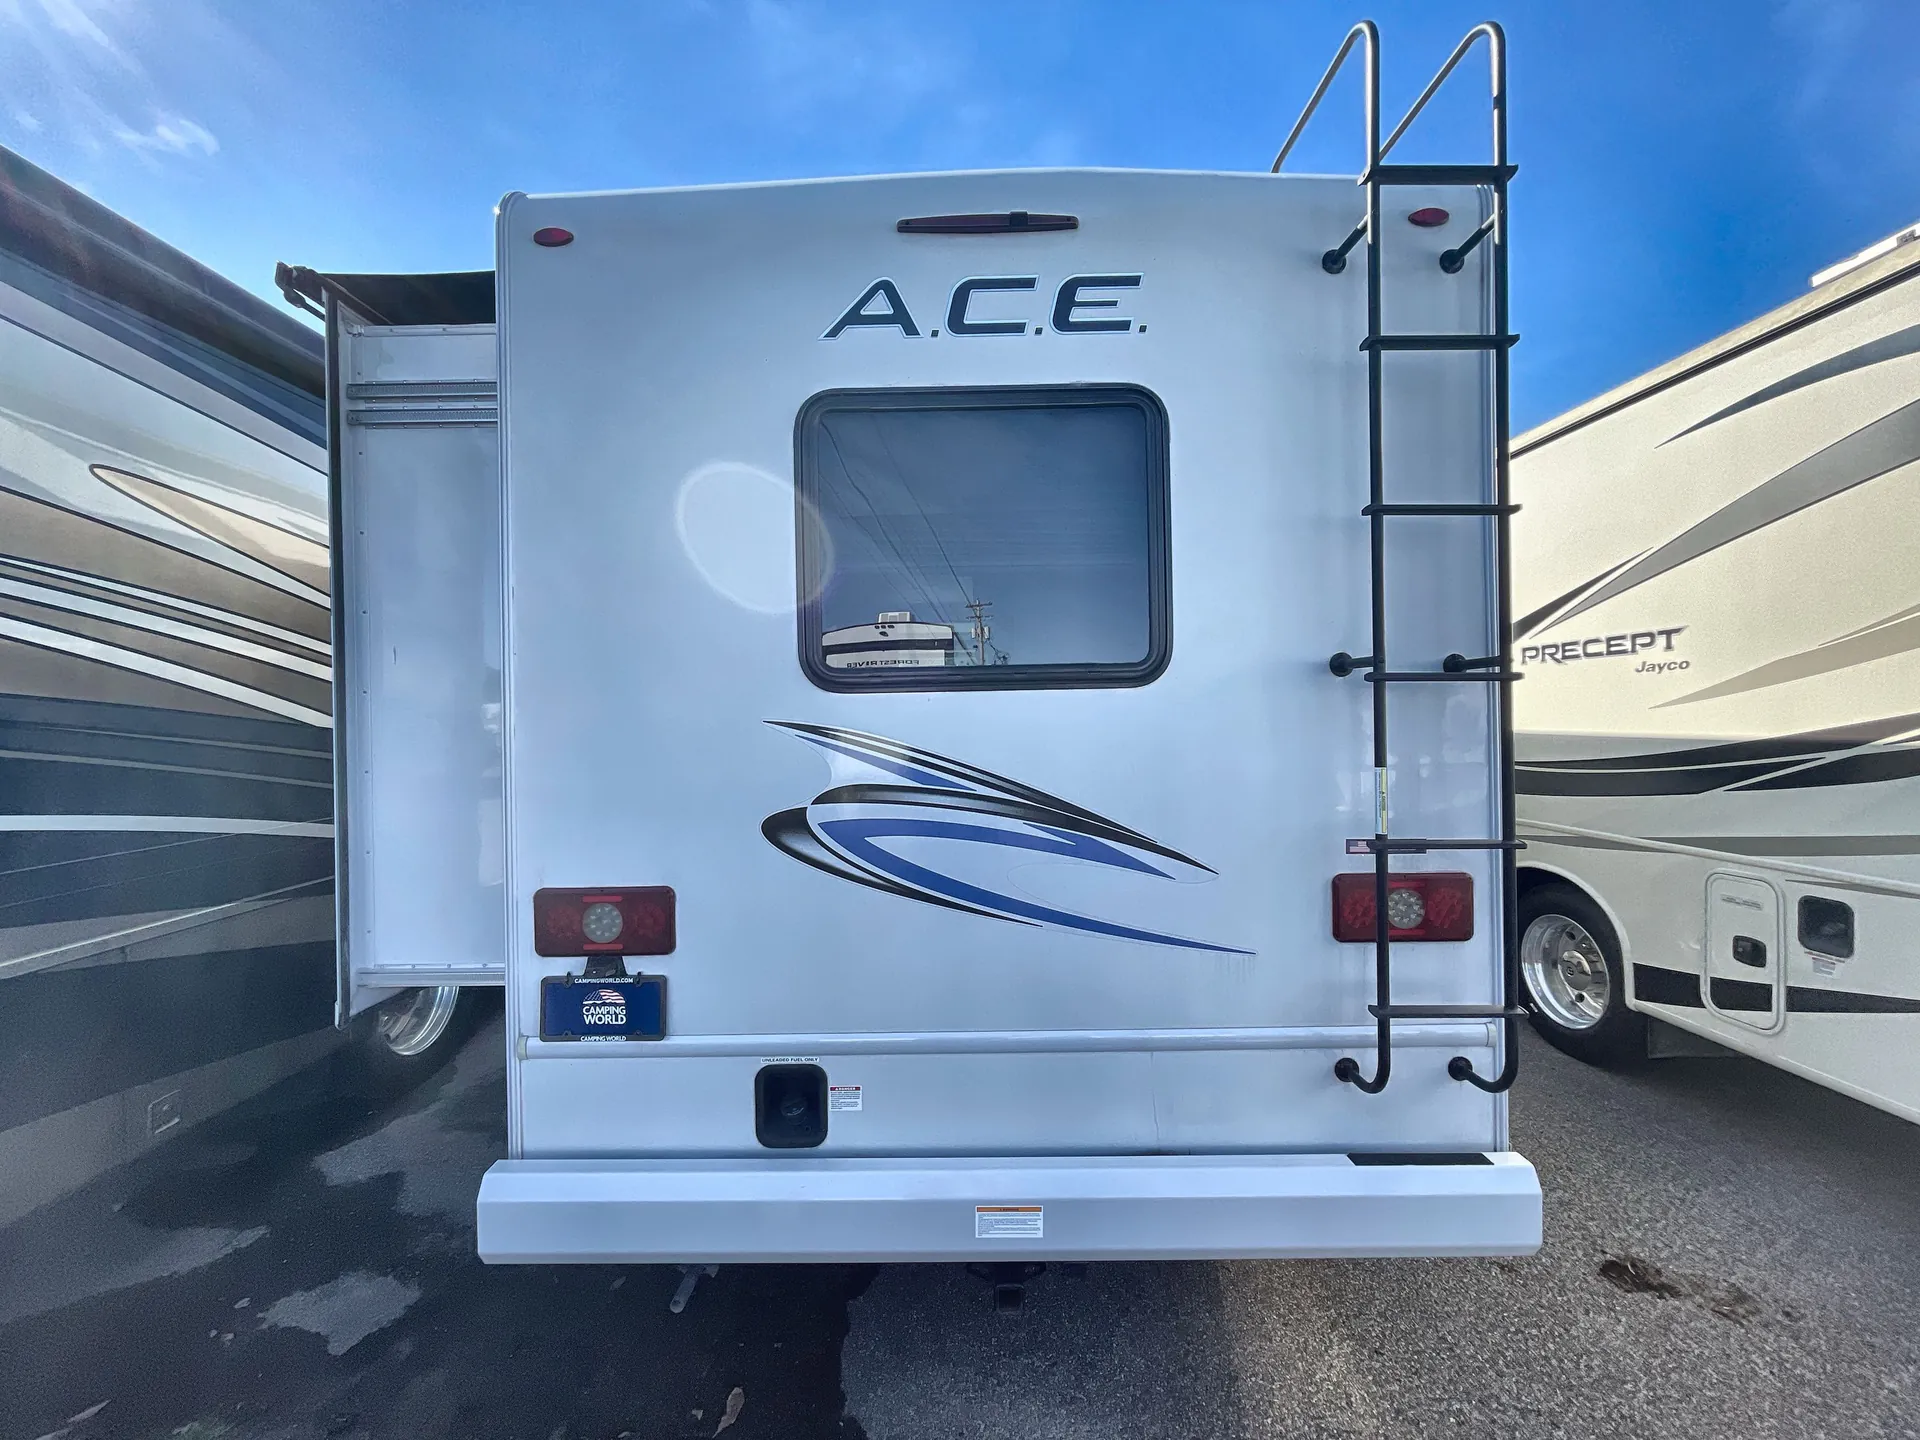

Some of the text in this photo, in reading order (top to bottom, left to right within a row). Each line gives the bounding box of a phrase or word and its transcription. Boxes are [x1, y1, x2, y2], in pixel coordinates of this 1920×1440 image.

[818, 273, 1148, 341] A.C.E.
[1521, 626, 1689, 666] PRECEPT
[1635, 660, 1690, 674] Jayco
[583, 1006, 626, 1014] CAMPING
[583, 1015, 626, 1024] WORLD
